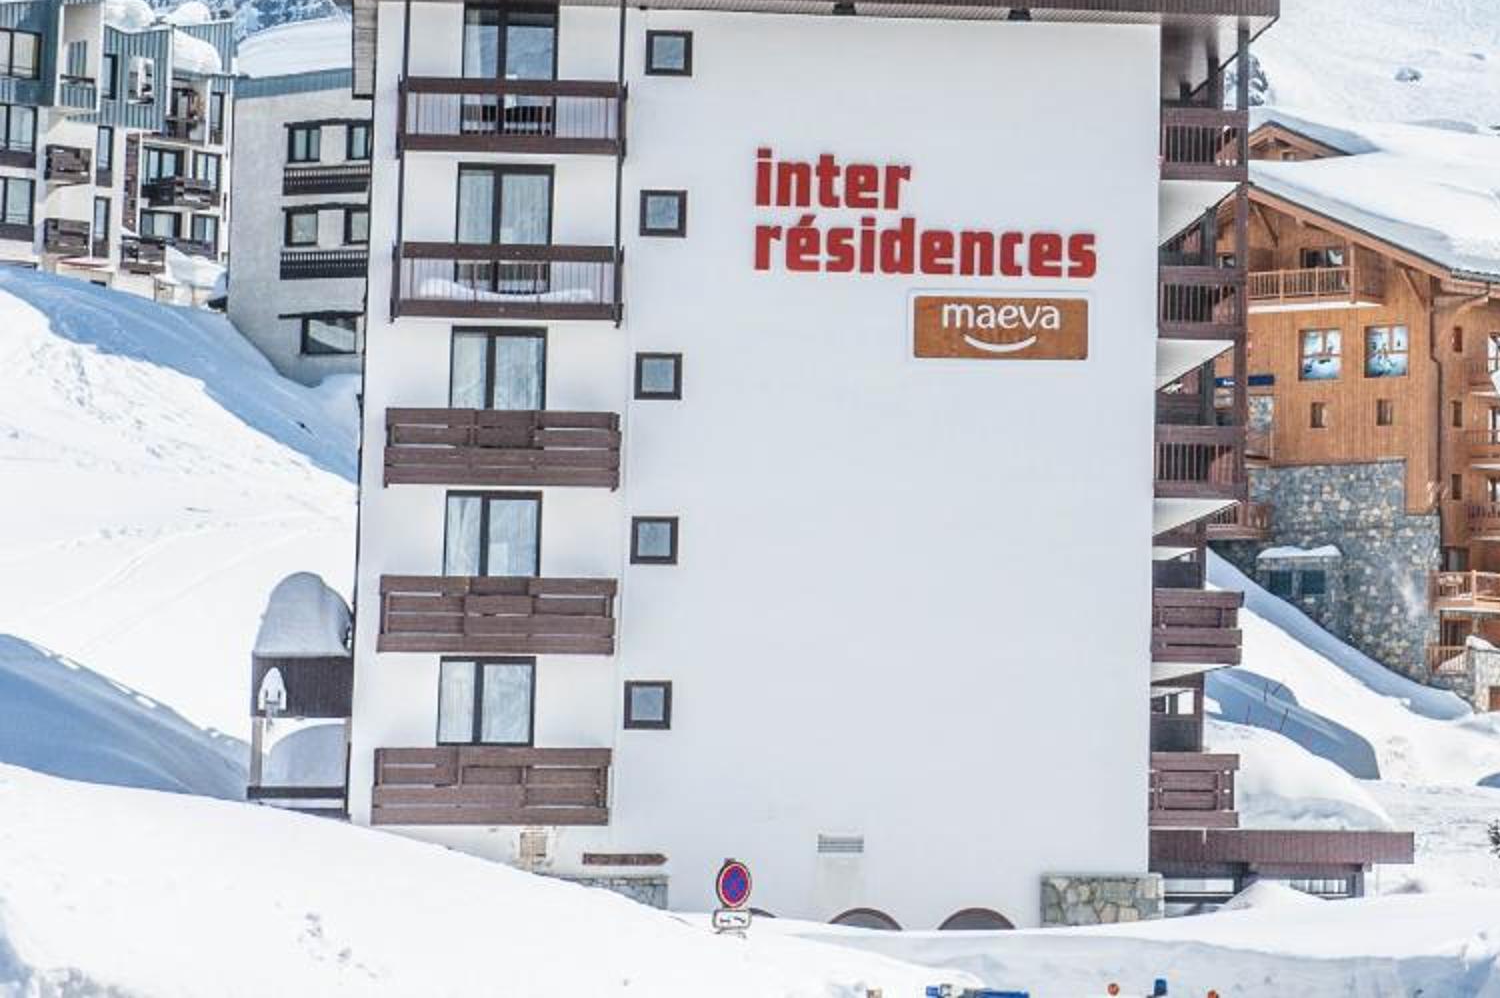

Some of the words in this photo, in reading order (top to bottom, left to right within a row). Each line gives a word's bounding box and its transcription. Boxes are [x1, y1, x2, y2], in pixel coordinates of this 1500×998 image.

[755, 147, 911, 209] inter
[753, 214, 1097, 278] résidences
[942, 301, 1061, 330] maeva
